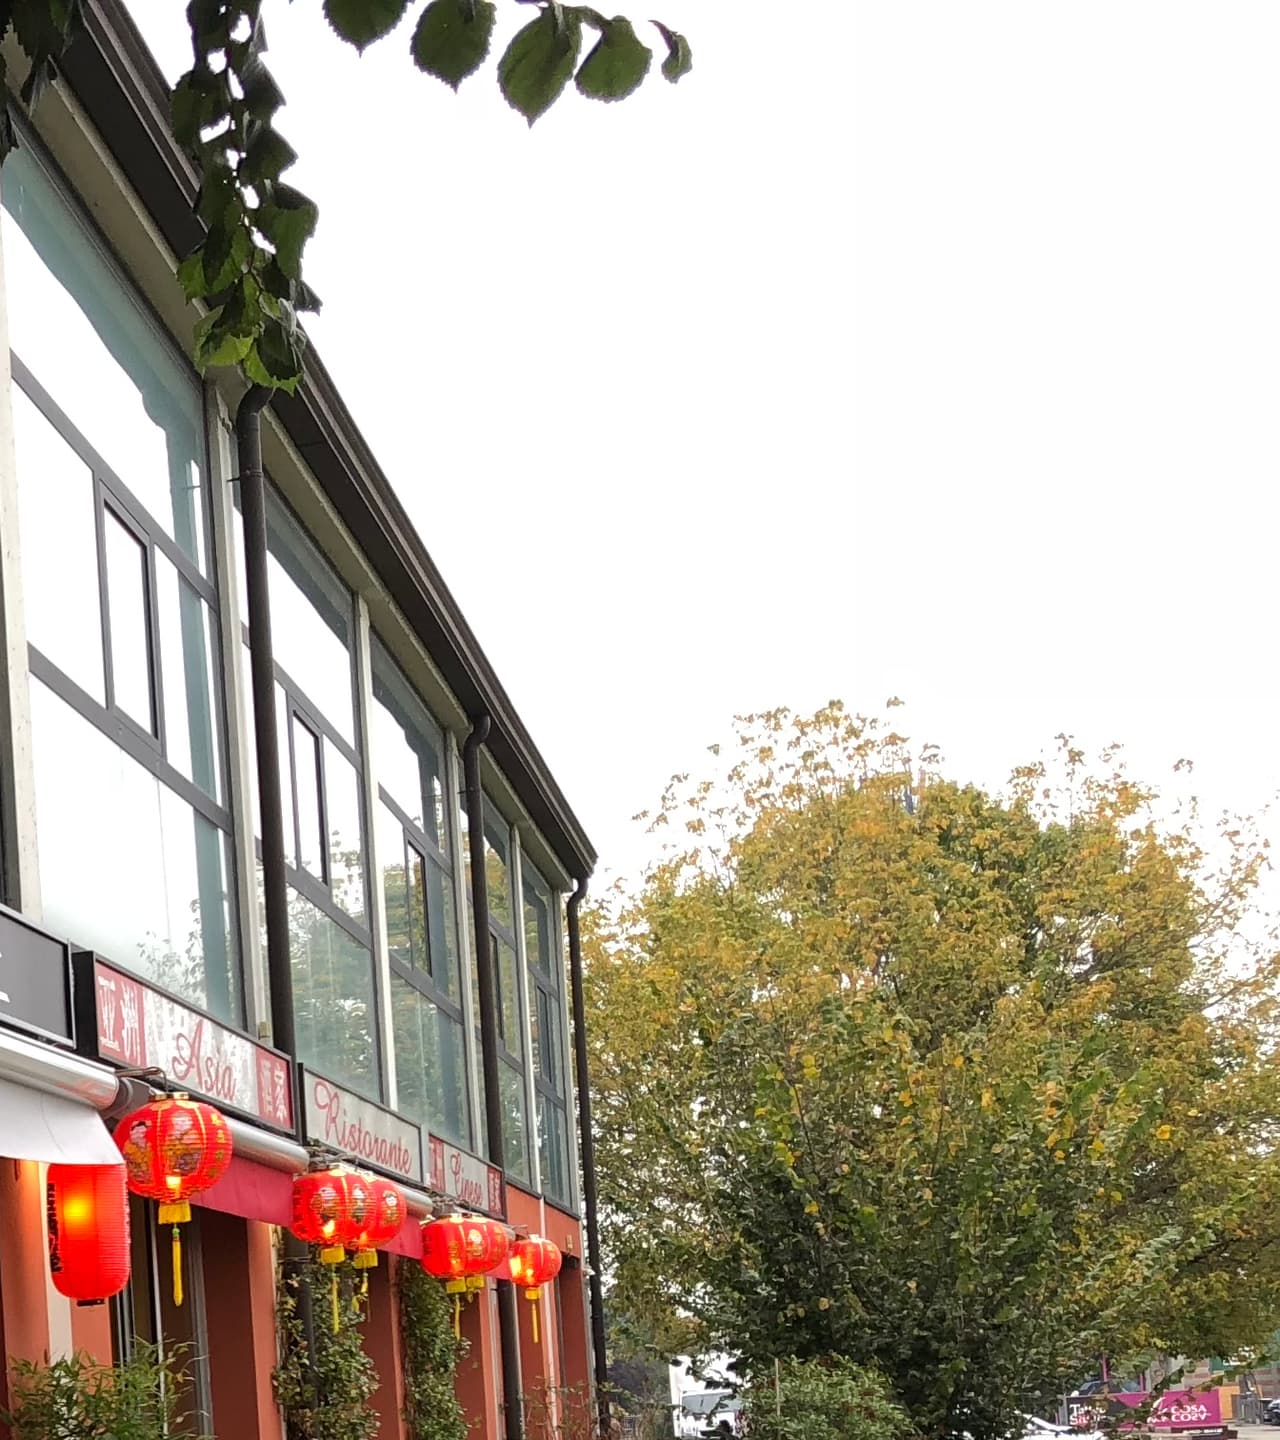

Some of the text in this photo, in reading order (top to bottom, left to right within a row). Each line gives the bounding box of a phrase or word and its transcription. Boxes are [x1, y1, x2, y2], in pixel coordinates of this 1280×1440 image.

[171, 1018, 237, 1102] Asia
[313, 1078, 413, 1176] Ristorante
[449, 1151, 483, 1206] Cinese
